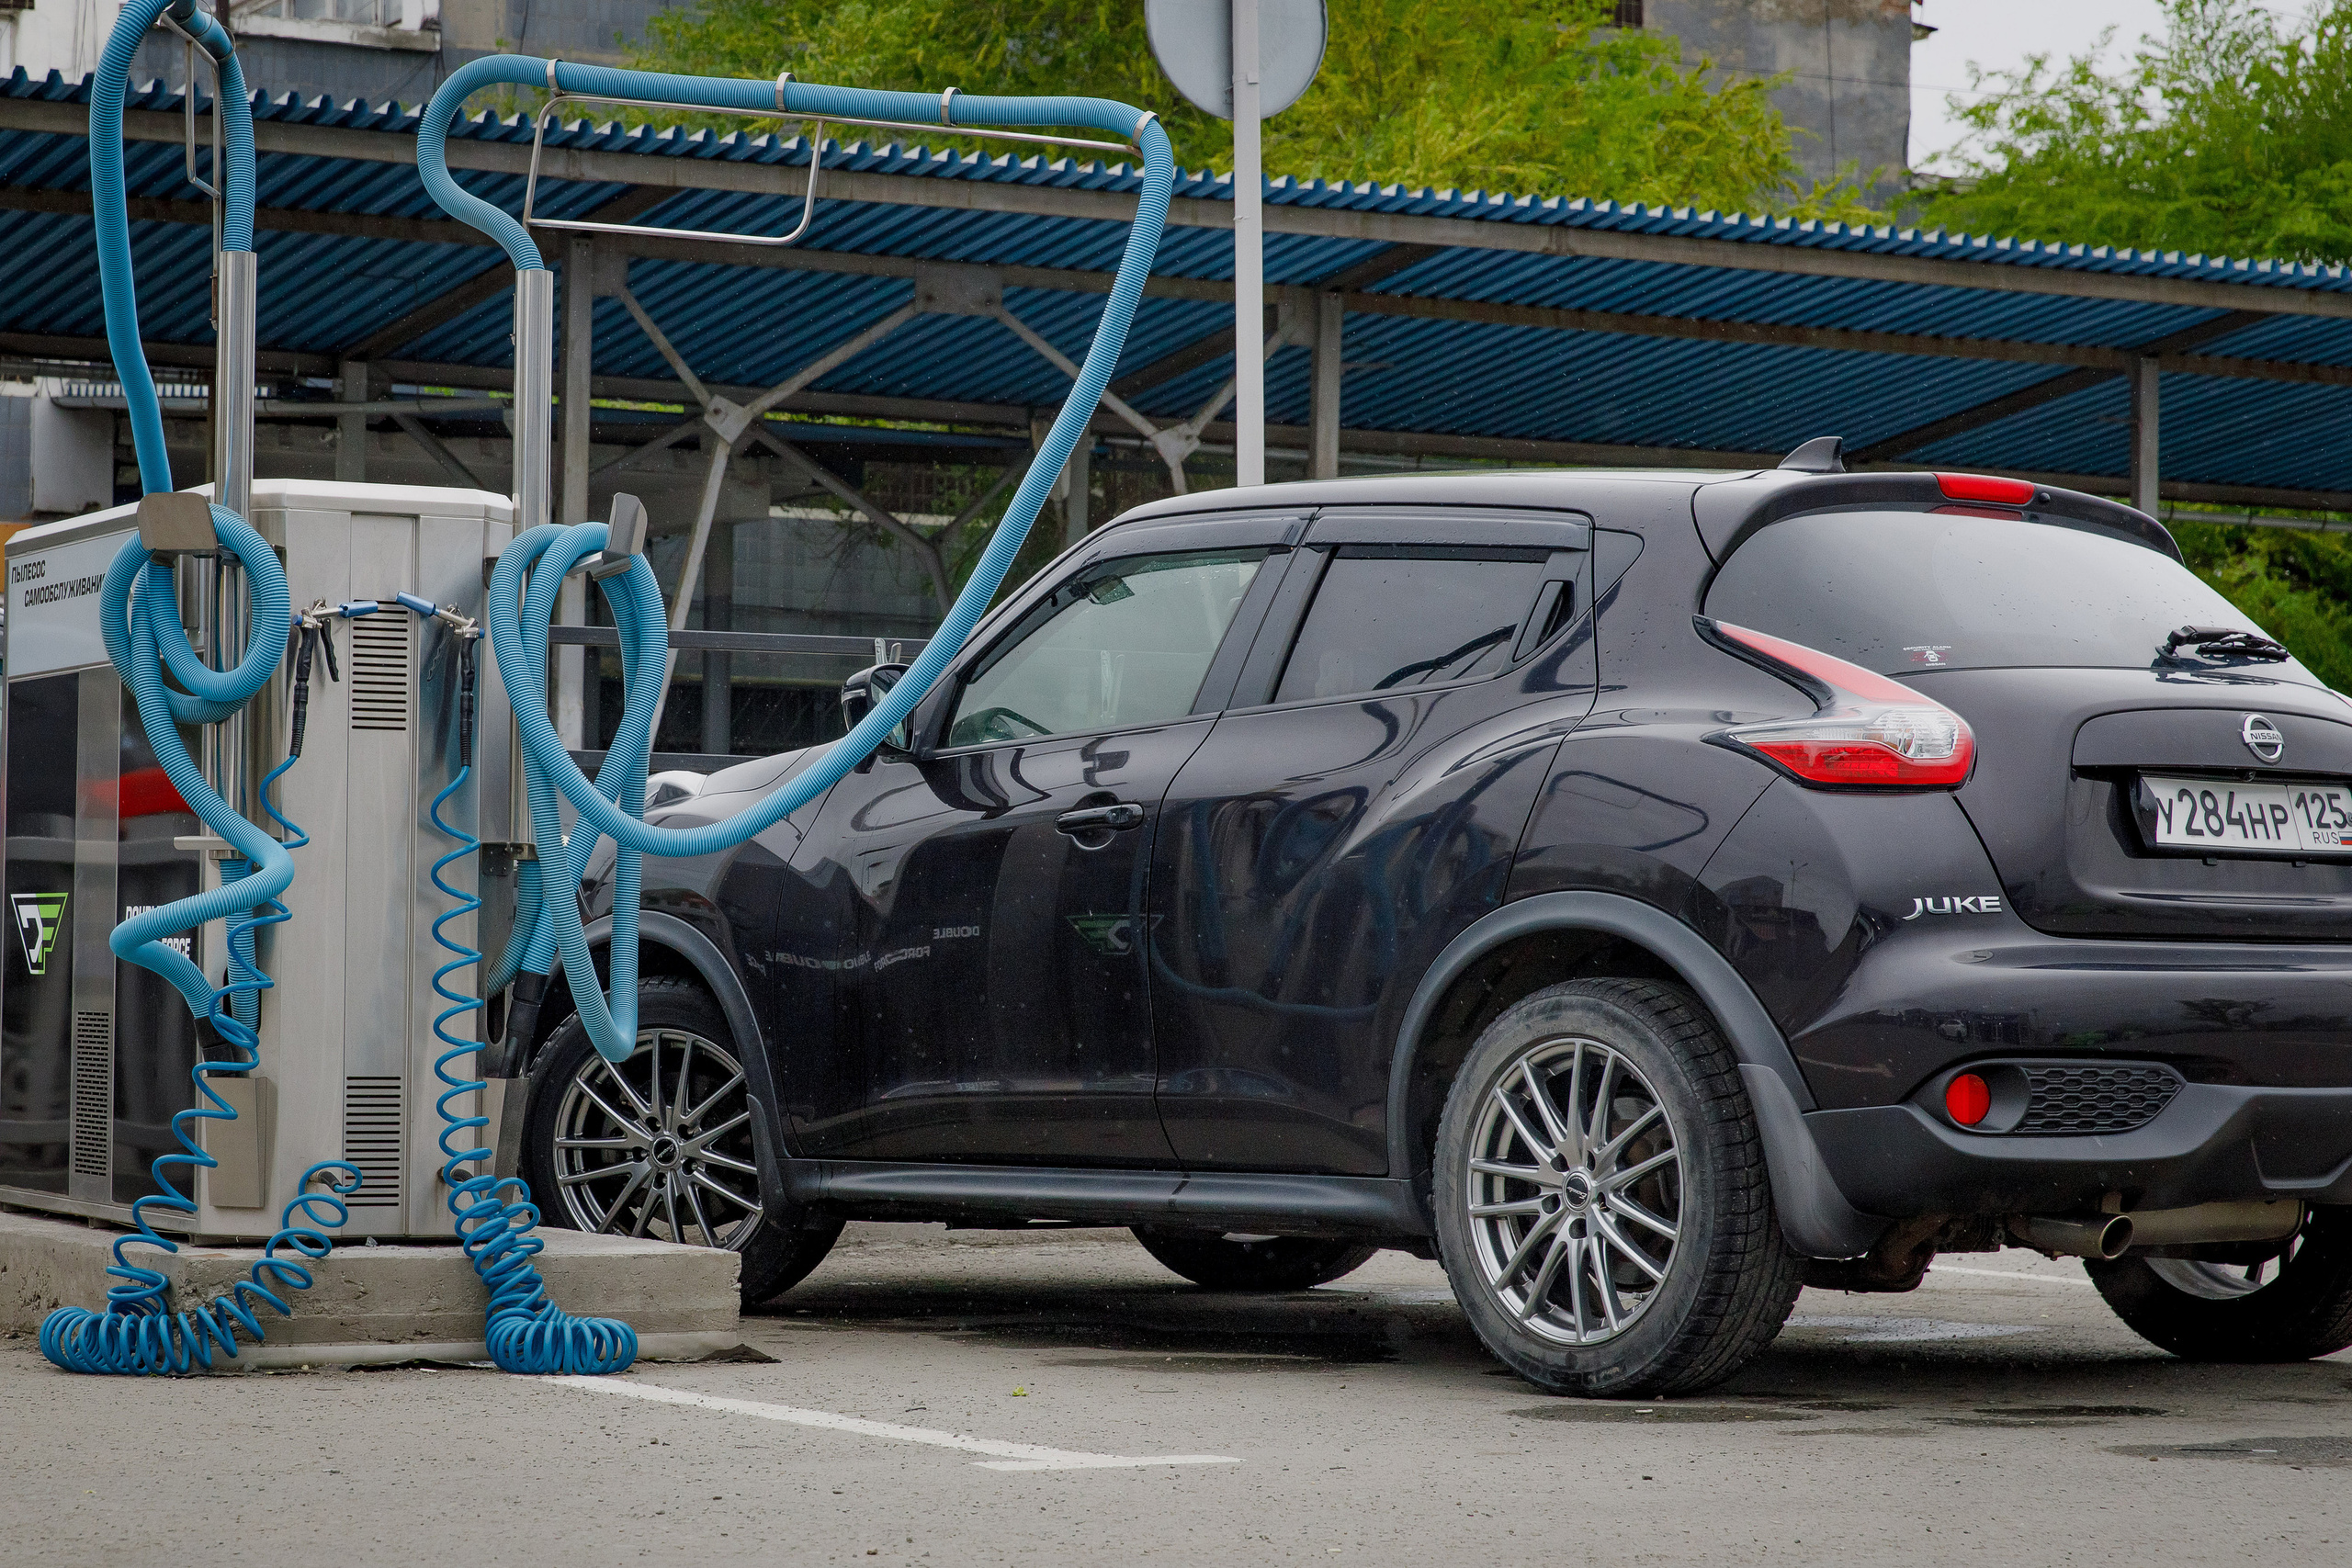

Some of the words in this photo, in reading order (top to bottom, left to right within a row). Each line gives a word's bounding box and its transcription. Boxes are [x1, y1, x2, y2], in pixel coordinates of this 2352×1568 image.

[11, 559, 46, 584] ПЫЛЕСОС
[24, 573, 107, 608] САМООБСЛУЖИВАНИ
[2250, 732, 2282, 741] NISSAN
[2295, 792, 2347, 829] 125
[2312, 831, 2340, 844] RUS
[1902, 896, 2003, 920] JUKE
